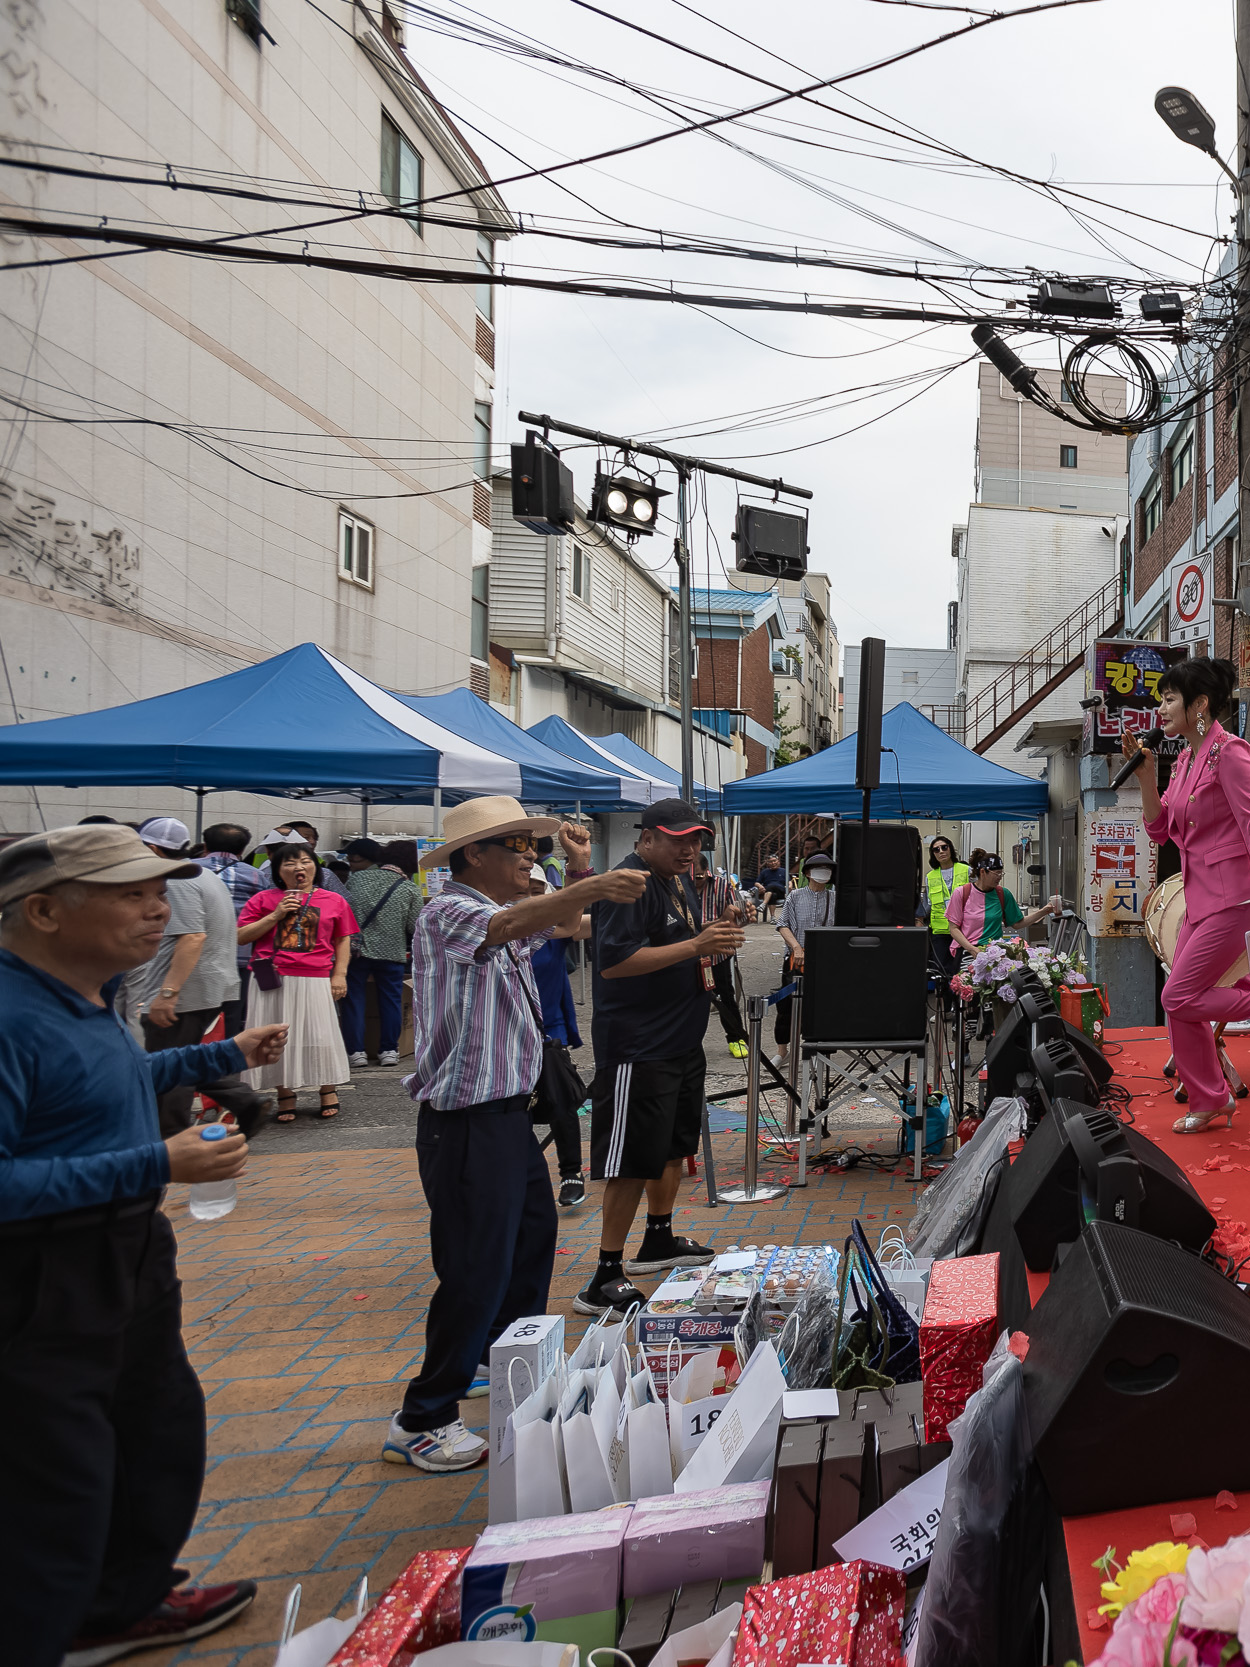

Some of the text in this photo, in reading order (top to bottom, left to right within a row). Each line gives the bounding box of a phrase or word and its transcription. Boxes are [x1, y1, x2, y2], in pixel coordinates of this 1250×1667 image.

[1097, 825, 1136, 839] 주차금지
[513, 1323, 541, 1338] 48
[657, 1321, 676, 1331] 농심
[679, 1319, 723, 1336] 육개장
